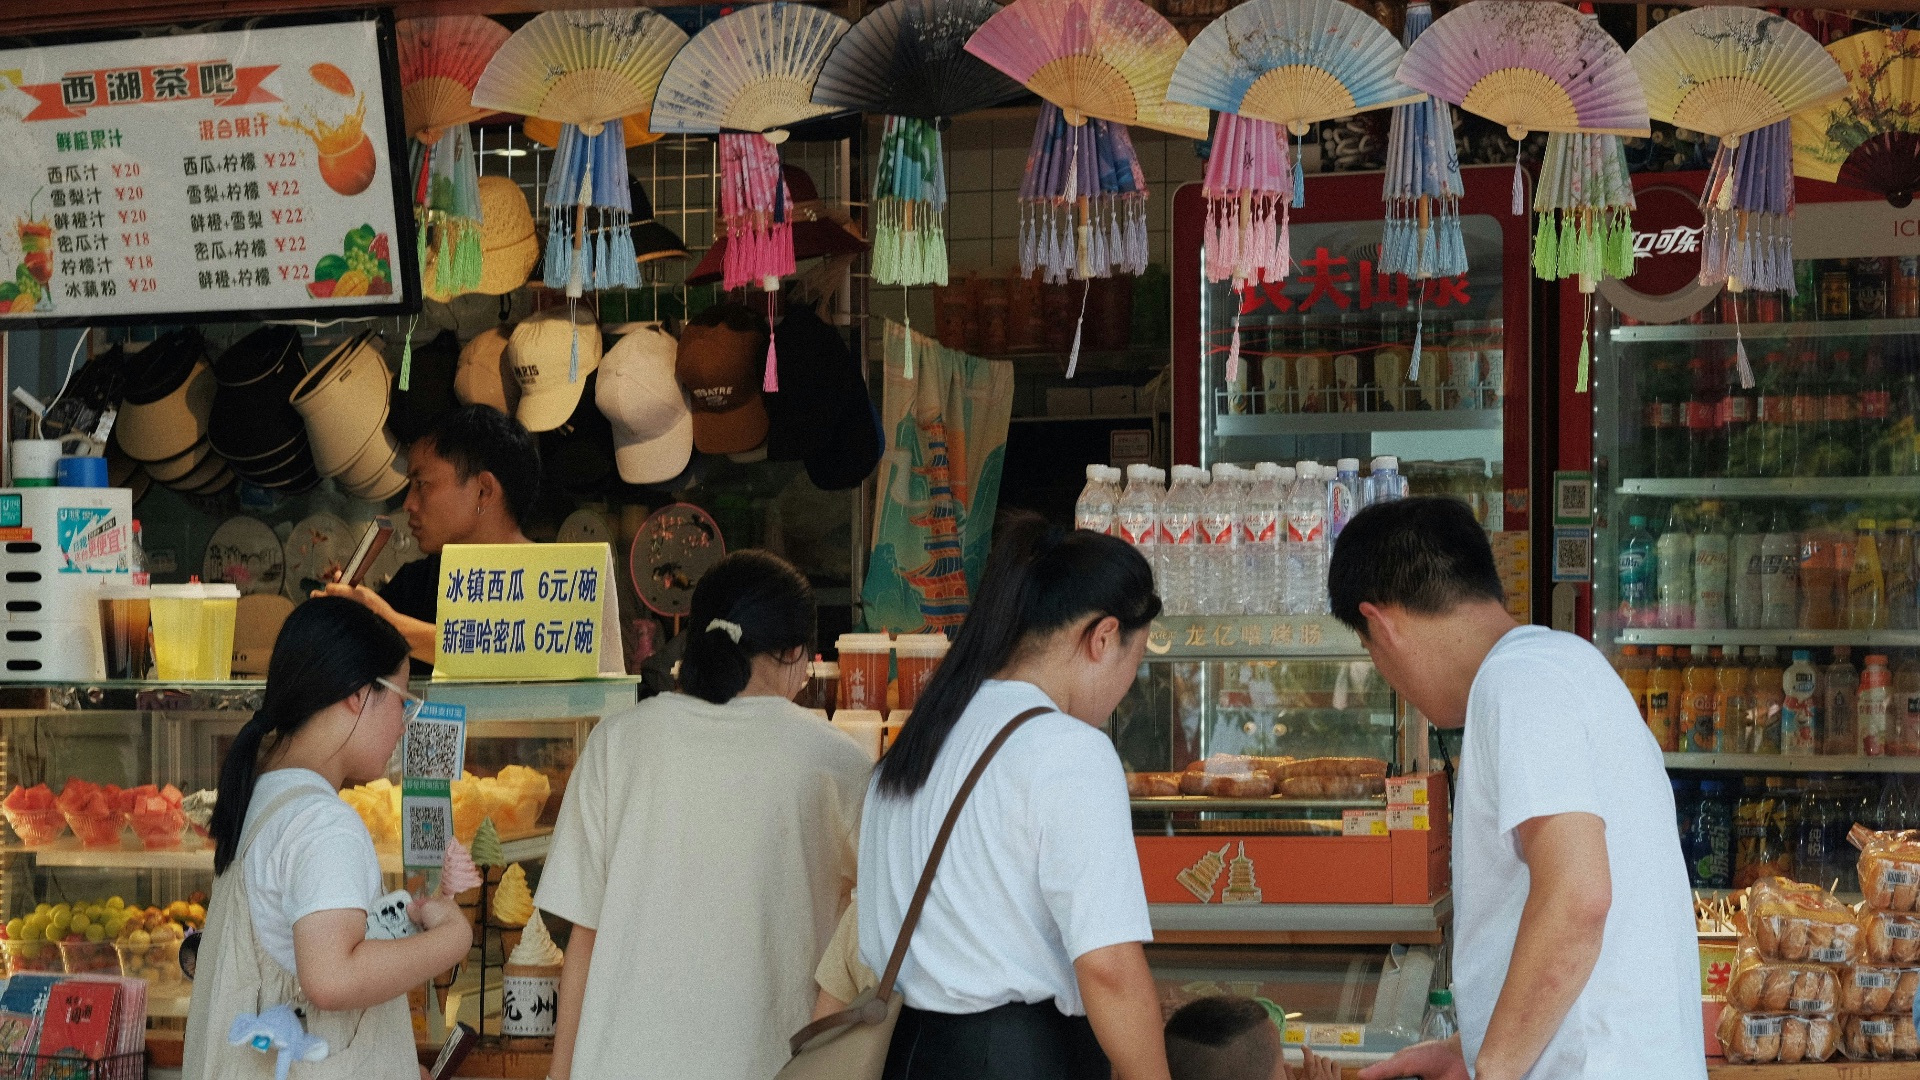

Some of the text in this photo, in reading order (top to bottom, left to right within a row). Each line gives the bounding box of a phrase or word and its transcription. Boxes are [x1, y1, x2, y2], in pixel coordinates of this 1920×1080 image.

[61, 62, 237, 106] 西湖茶吧
[56, 128, 123, 152] 鲜榨果汁
[199, 116, 268, 141] 混合果汁
[47, 163, 140, 184] 西瓜汁 ¥20
[183, 152, 297, 176] 西瓜+柠檬 ¥22
[51, 186, 143, 208] 雪梨汁 ¥20
[186, 180, 300, 205] 雪梨+柠檬 ¥22
[54, 209, 147, 230] 鲜橙汁 ¥20
[190, 208, 303, 233] 鲜橙+雪梨 ¥22
[121, 232, 150, 247] ¥18
[275, 236, 307, 252] ¥22
[1632, 225, 1705, 258] 口可乐
[61, 255, 153, 276] 柠檬汁 ¥18
[198, 264, 310, 289] 鲜橙+柠檬 ¥22
[65, 278, 157, 298] 冰藕粉 ¥20
[445, 567, 598, 603] 冰镇西瓜 6元/碗
[442, 618, 594, 654] 新疆哈密瓜 6元/碗
[1807, 828, 1822, 857] 纯悦
